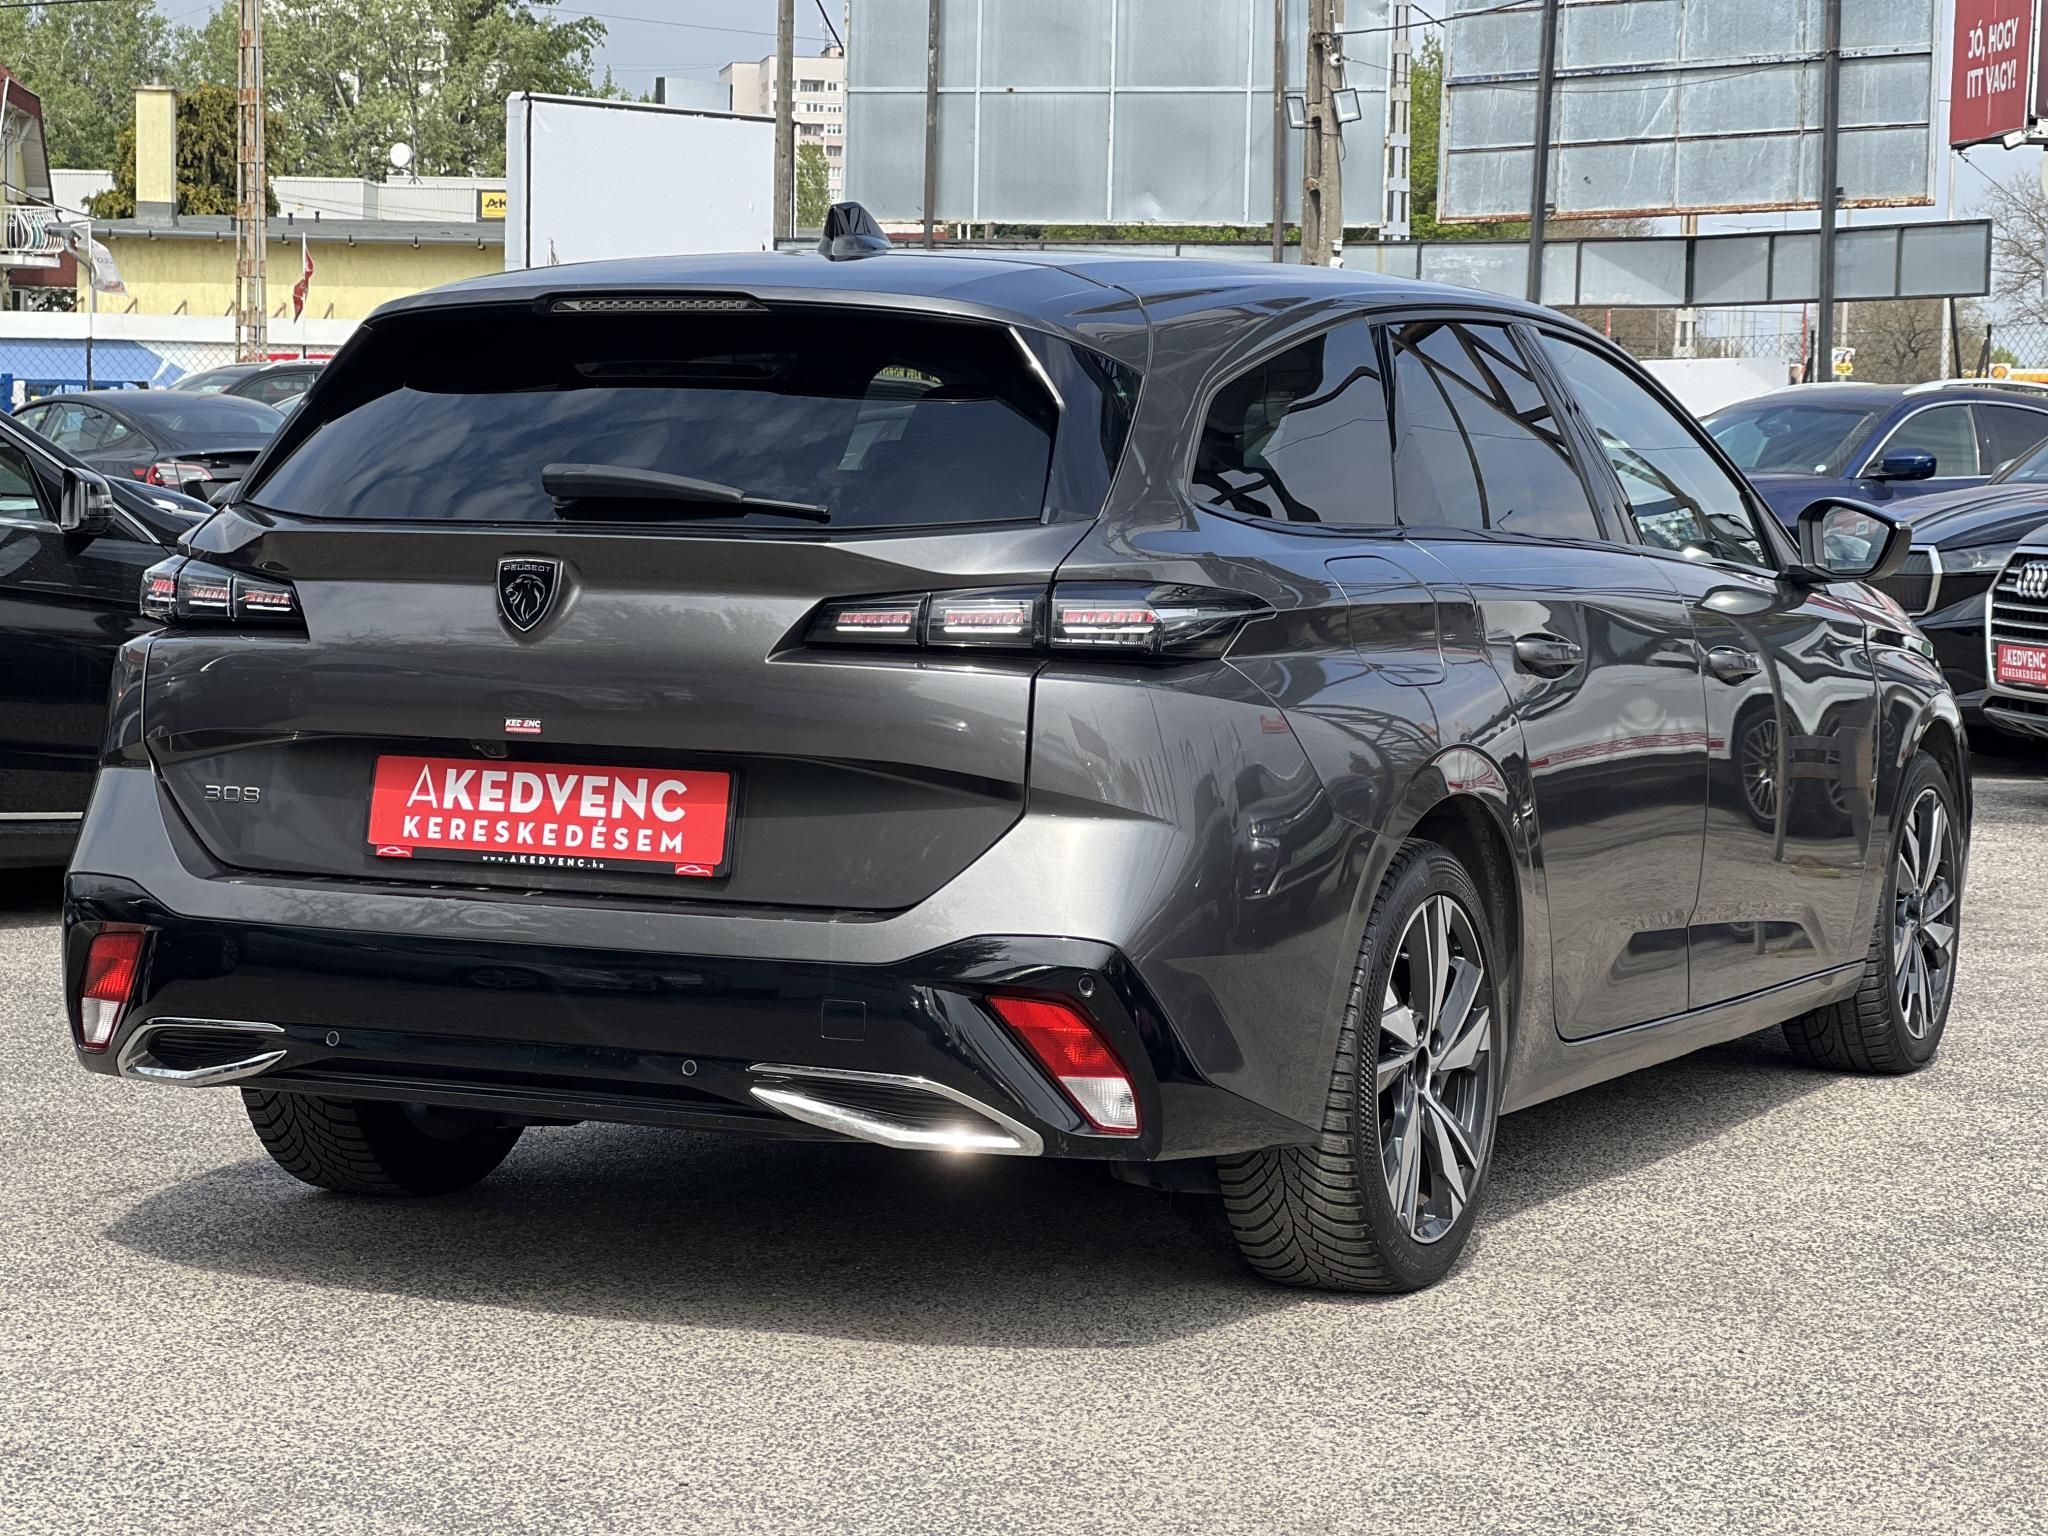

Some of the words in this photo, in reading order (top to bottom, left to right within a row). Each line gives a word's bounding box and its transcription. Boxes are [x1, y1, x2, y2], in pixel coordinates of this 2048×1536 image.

[1968, 19, 1985, 61] JÓ,
[1988, 17, 2019, 53] HOGY
[1967, 67, 1984, 99] ITT
[1985, 59, 2017, 94] VAGY!
[503, 564, 551, 572] PEUGEOT
[204, 784, 260, 803] 308
[402, 815, 683, 854] KERESKEDÉSEM
[482, 854, 604, 869] www.AKEDVENC.hu
